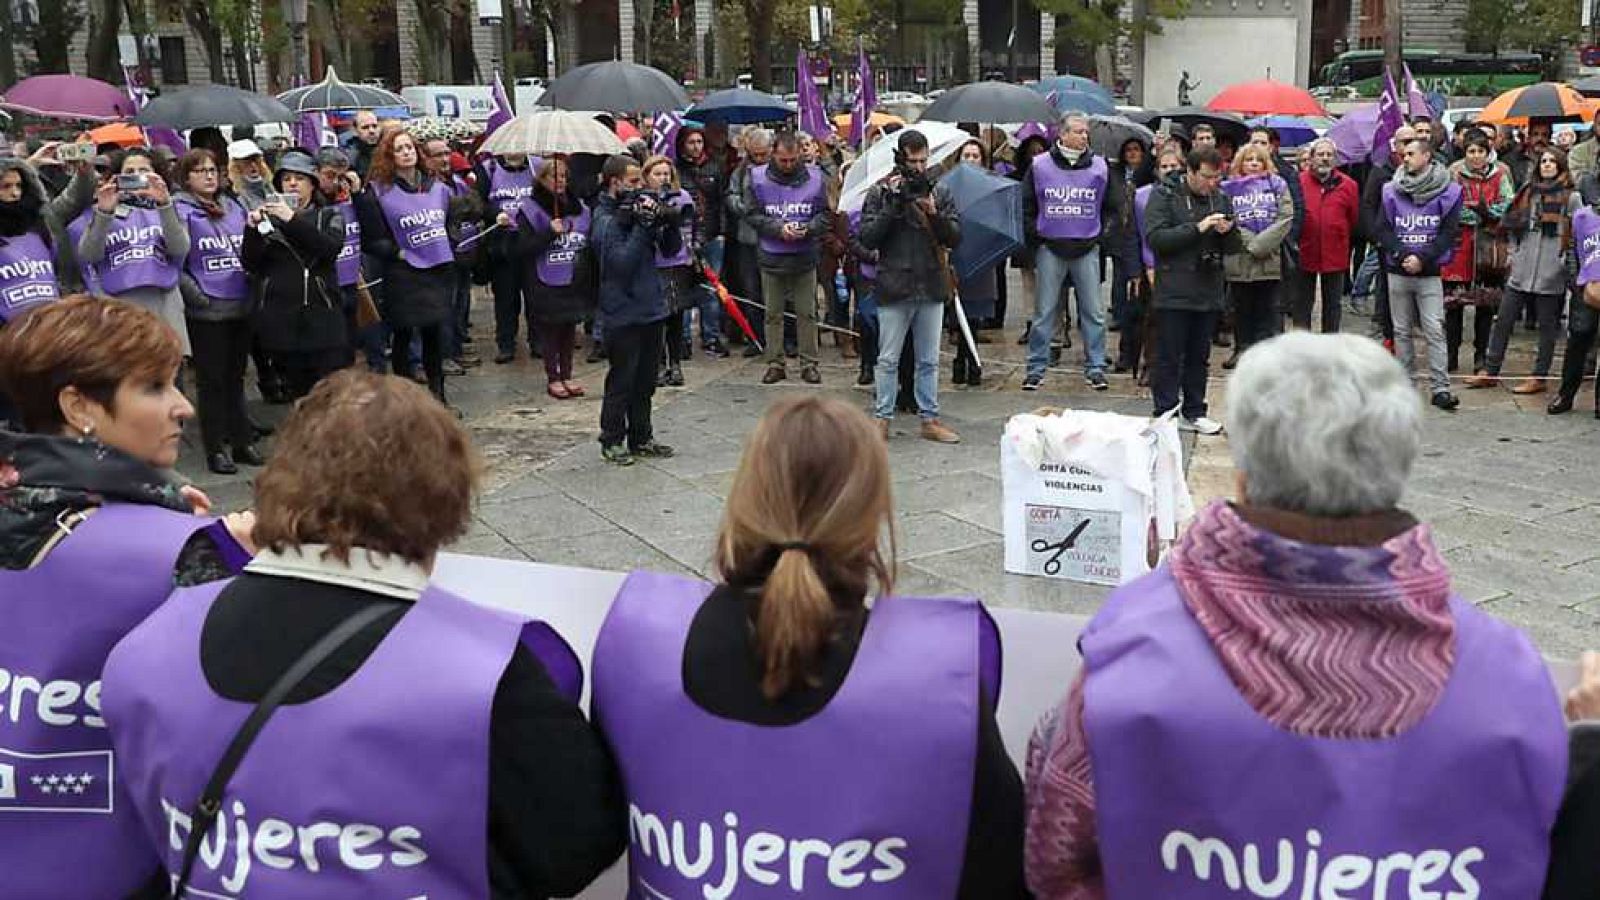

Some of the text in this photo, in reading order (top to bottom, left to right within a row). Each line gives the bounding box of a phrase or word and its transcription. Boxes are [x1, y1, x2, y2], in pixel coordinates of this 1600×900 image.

[1040, 463, 1067, 473] ORTA
[1045, 480, 1103, 494] VIOLENCIAS
[629, 803, 908, 900] mujeres
[1161, 828, 1485, 900] mujeres
